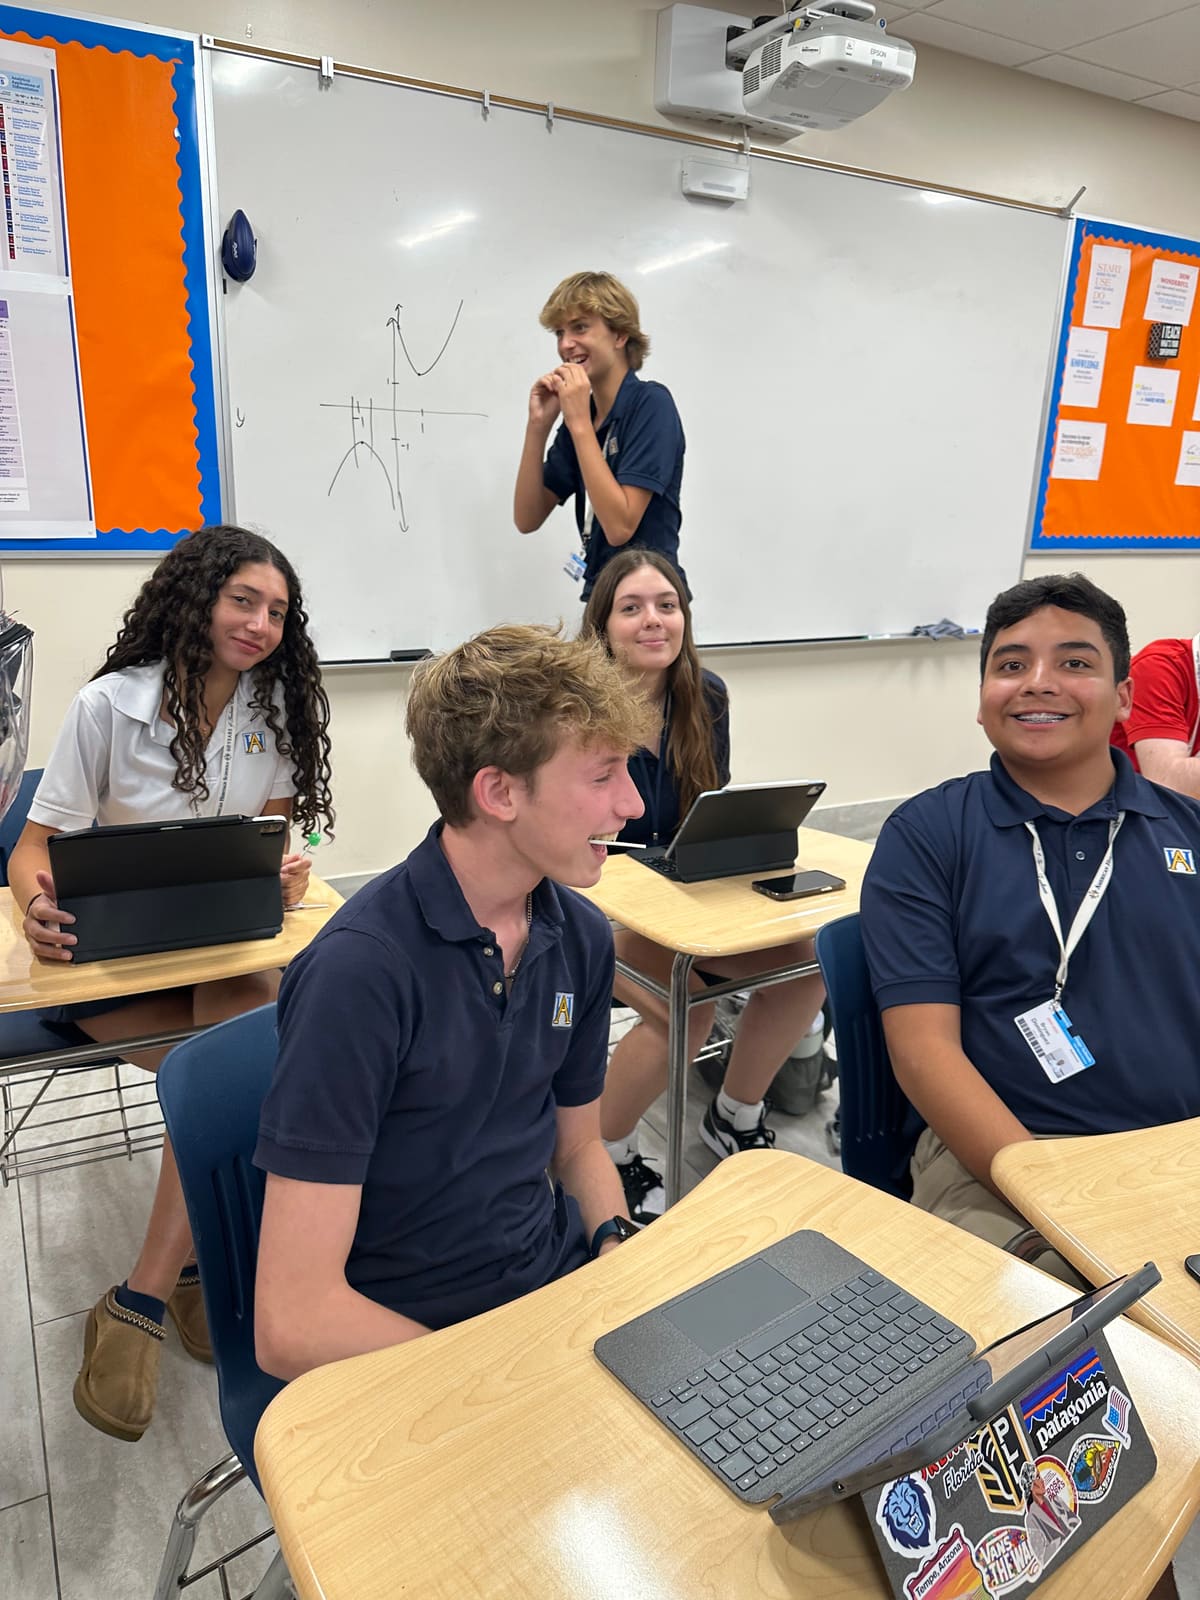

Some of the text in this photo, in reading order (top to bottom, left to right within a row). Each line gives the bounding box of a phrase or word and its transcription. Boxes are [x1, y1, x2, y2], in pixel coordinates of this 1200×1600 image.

[870, 47, 888, 59] EPSON
[1036, 1380, 1108, 1451] patagonia
[943, 1448, 984, 1500] Florida
[1046, 1477, 1061, 1494] ROSA
[1048, 1480, 1066, 1502] PARKS
[980, 1530, 1012, 1564] VANS
[915, 1543, 962, 1597] Tempe, Arizona
